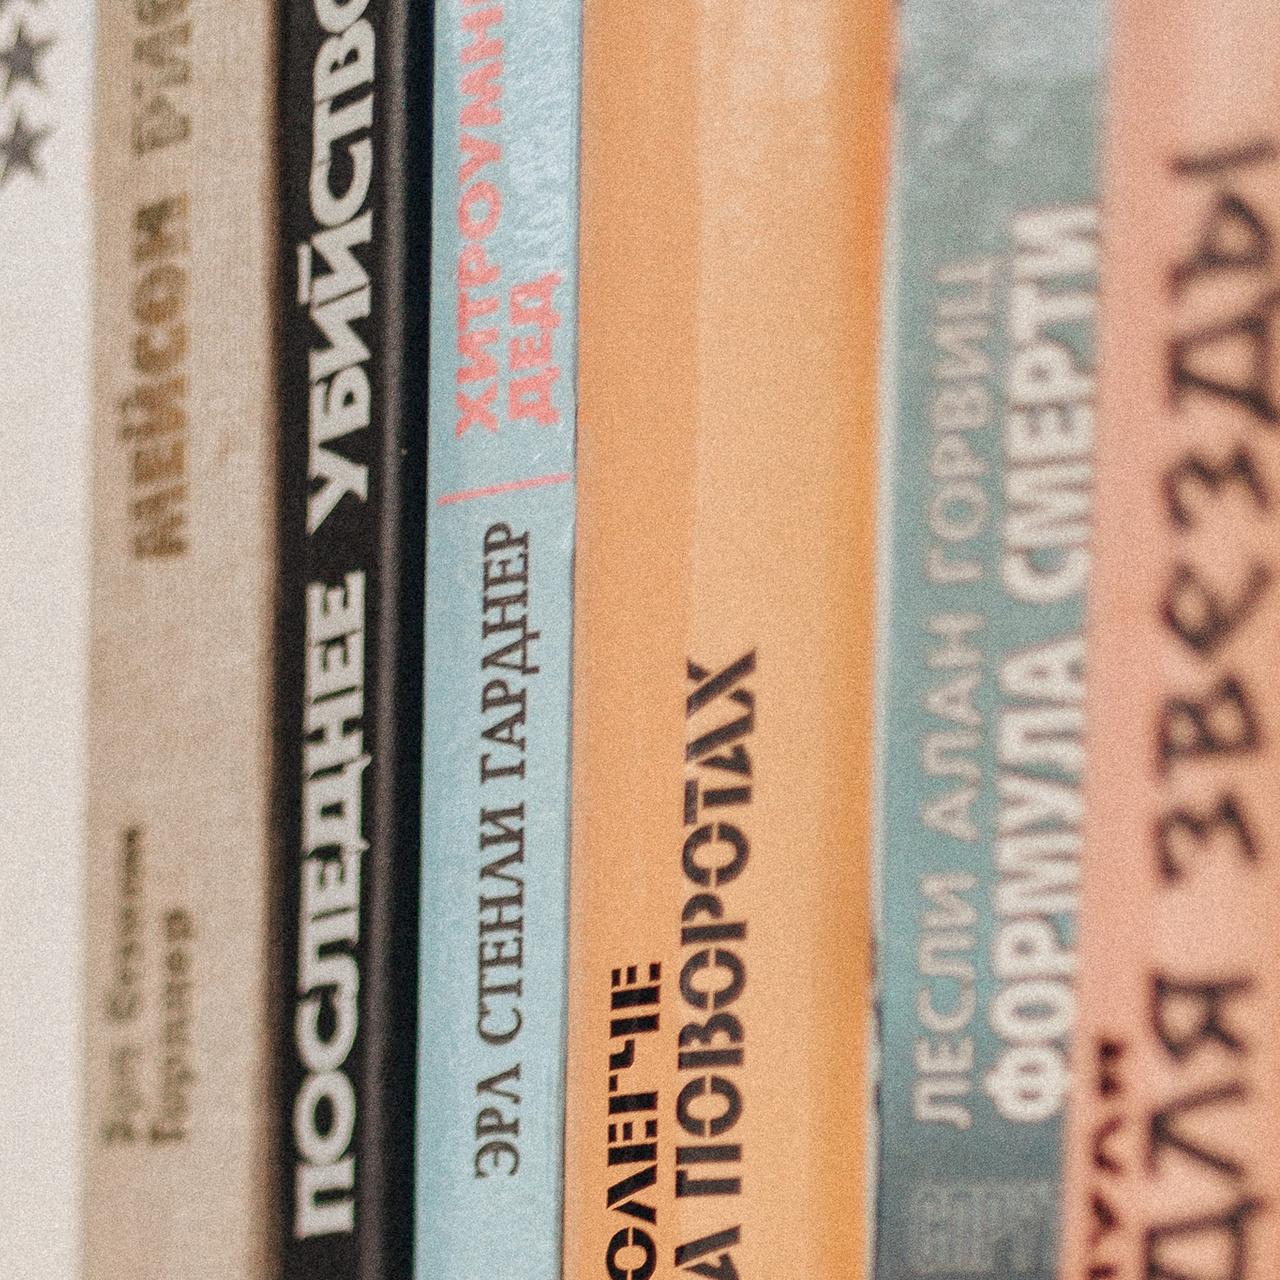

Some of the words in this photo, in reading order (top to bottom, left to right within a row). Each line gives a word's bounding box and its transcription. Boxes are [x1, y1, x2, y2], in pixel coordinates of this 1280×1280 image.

[454, 0, 507, 440] ХИТРОУМН
[508, 272, 563, 426] ДЕД
[926, 255, 1002, 585] ГОРВИЦ
[1000, 206, 1103, 603] СМЕРТИ
[480, 521, 540, 783] ГАРДНЕР
[920, 611, 986, 842] АЛАН
[292, 571, 372, 1239] ПОСЛЕДНЕЕ
[476, 803, 526, 1046] СТЕНЛИ
[674, 648, 757, 1199] ПОВОРОТАХ
[912, 869, 981, 1132] ЛЕСЛИ
[983, 634, 1090, 1124] ФОРМУЛА
[475, 1062, 522, 1180] ЭРЛ
